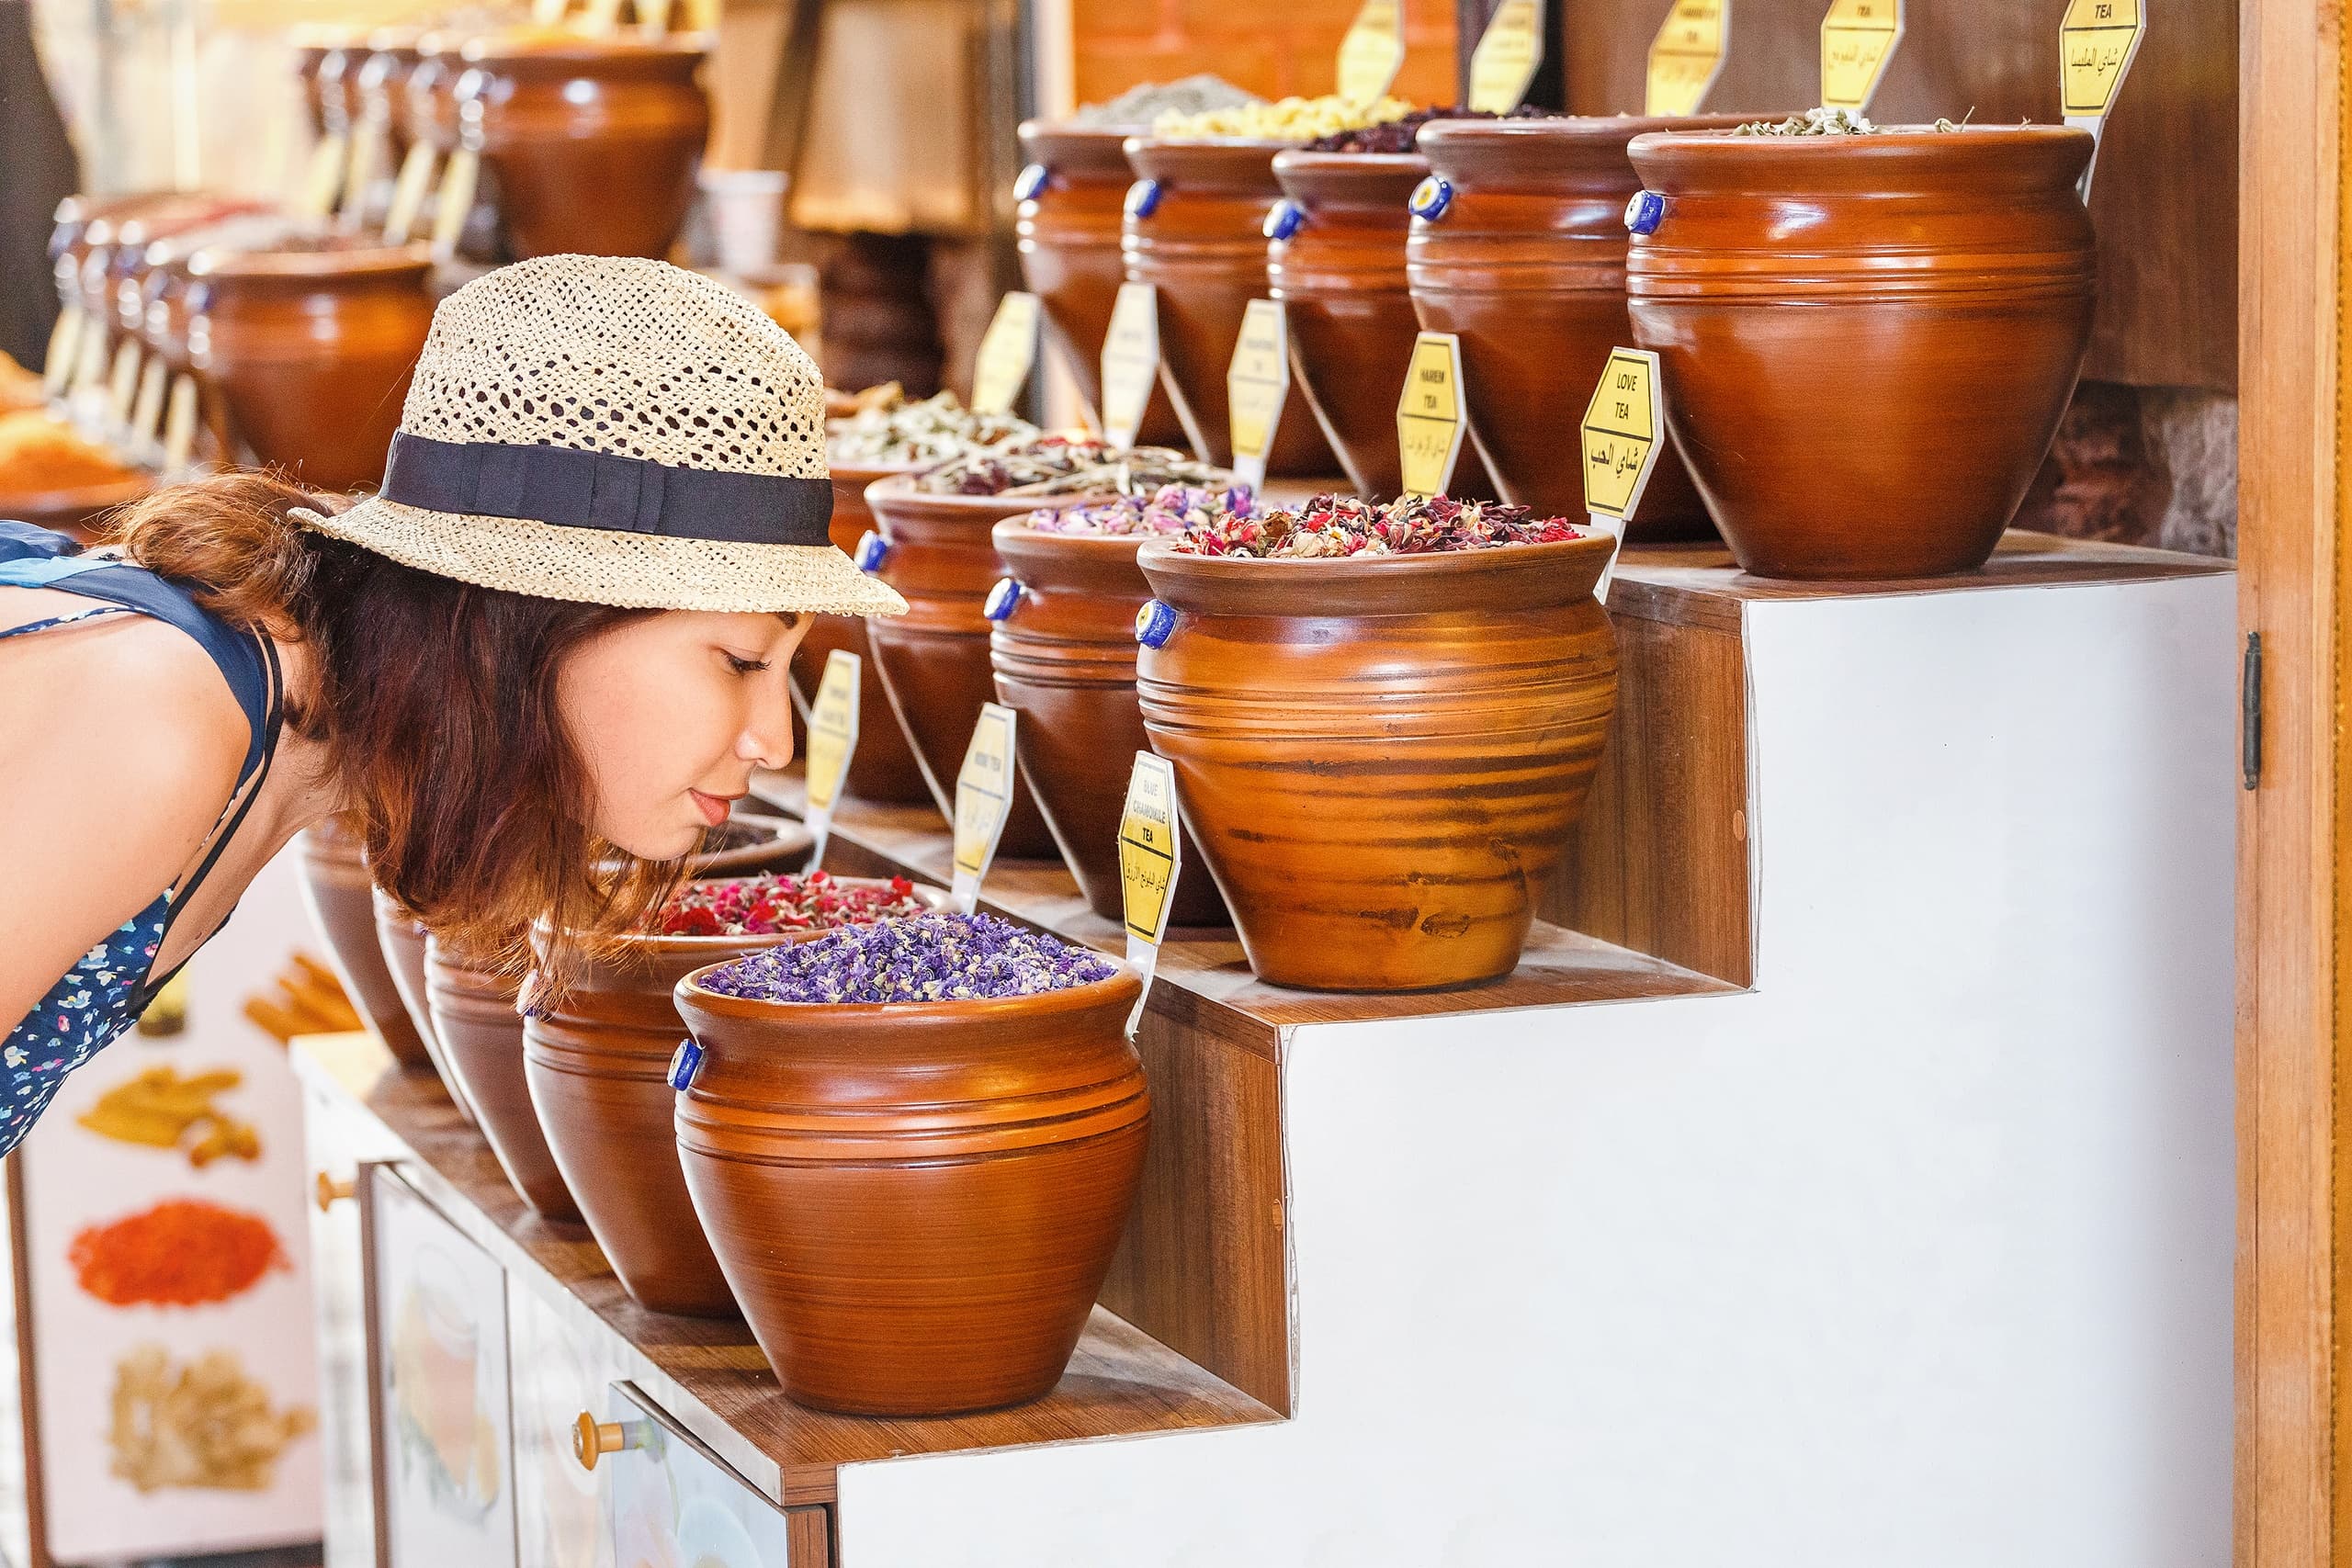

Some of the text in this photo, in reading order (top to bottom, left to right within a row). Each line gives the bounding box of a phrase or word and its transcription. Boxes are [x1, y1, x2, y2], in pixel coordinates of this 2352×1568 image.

[2095, 4, 2111, 18] TEA
[2098, 47, 2118, 77] شاي
[1617, 372, 1638, 391] LOVE
[1424, 394, 1437, 410] TEA
[1614, 401, 1629, 420] TEA
[1590, 442, 1639, 479] شاي الحب
[1144, 779, 1159, 797] BLUE
[1133, 799, 1166, 825] CHAMOMILE
[1142, 827, 1154, 843] TEA
